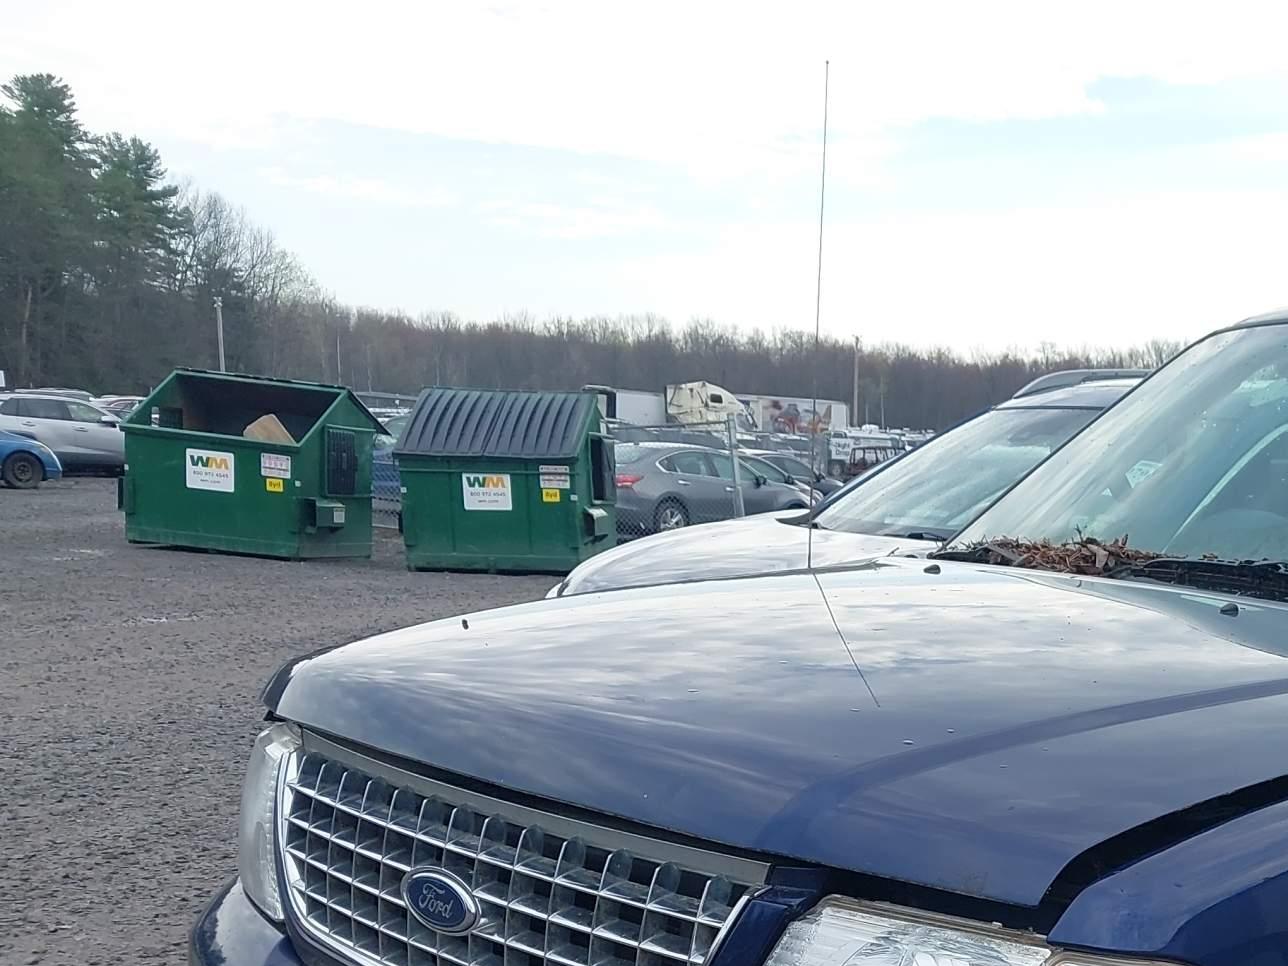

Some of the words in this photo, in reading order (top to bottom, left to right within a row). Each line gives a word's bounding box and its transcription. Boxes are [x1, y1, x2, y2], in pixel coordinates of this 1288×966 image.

[189, 454, 229, 470] WM
[465, 476, 506, 488] WM
[418, 883, 454, 919] Ford
